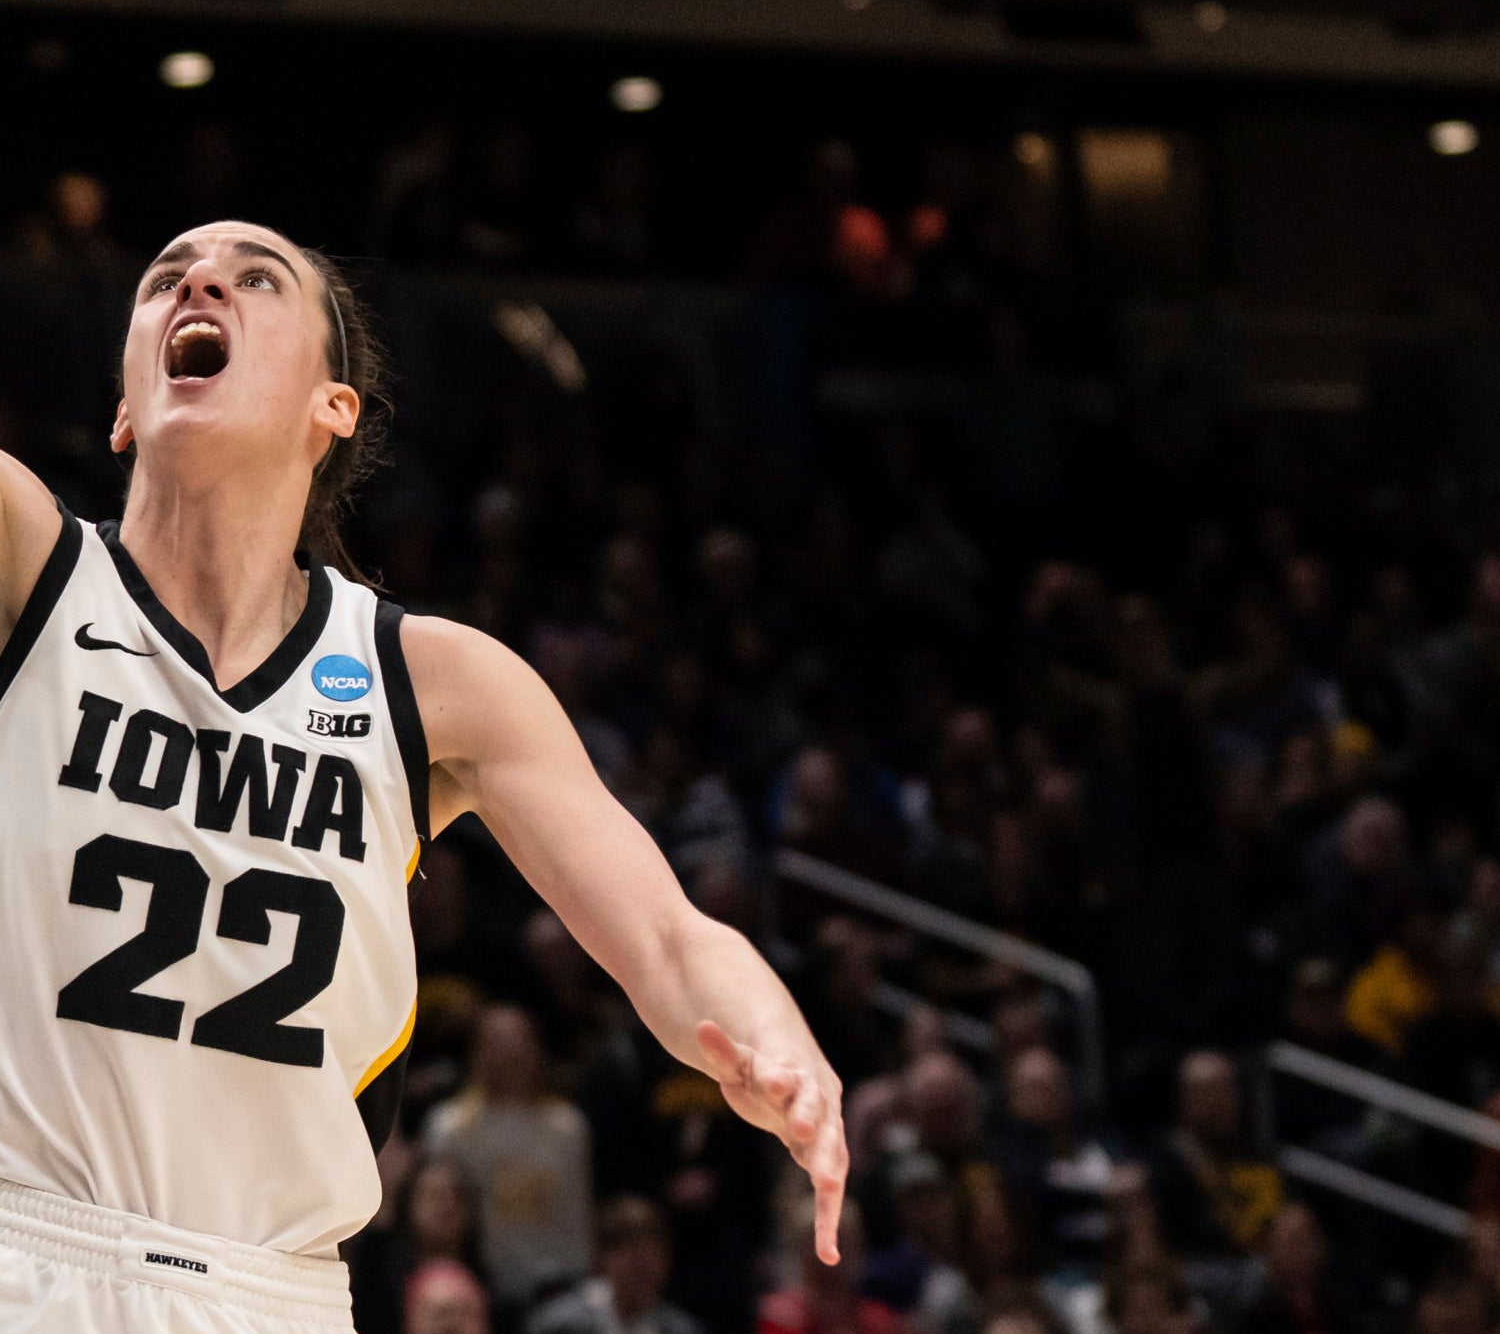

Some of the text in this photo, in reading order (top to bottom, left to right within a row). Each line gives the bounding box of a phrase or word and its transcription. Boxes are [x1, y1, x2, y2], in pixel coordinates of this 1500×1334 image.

[320, 676, 368, 689] NCAA
[58, 691, 368, 862] IOWA
[56, 833, 347, 1068] 22
[145, 1252, 208, 1274] HAWKEYES
